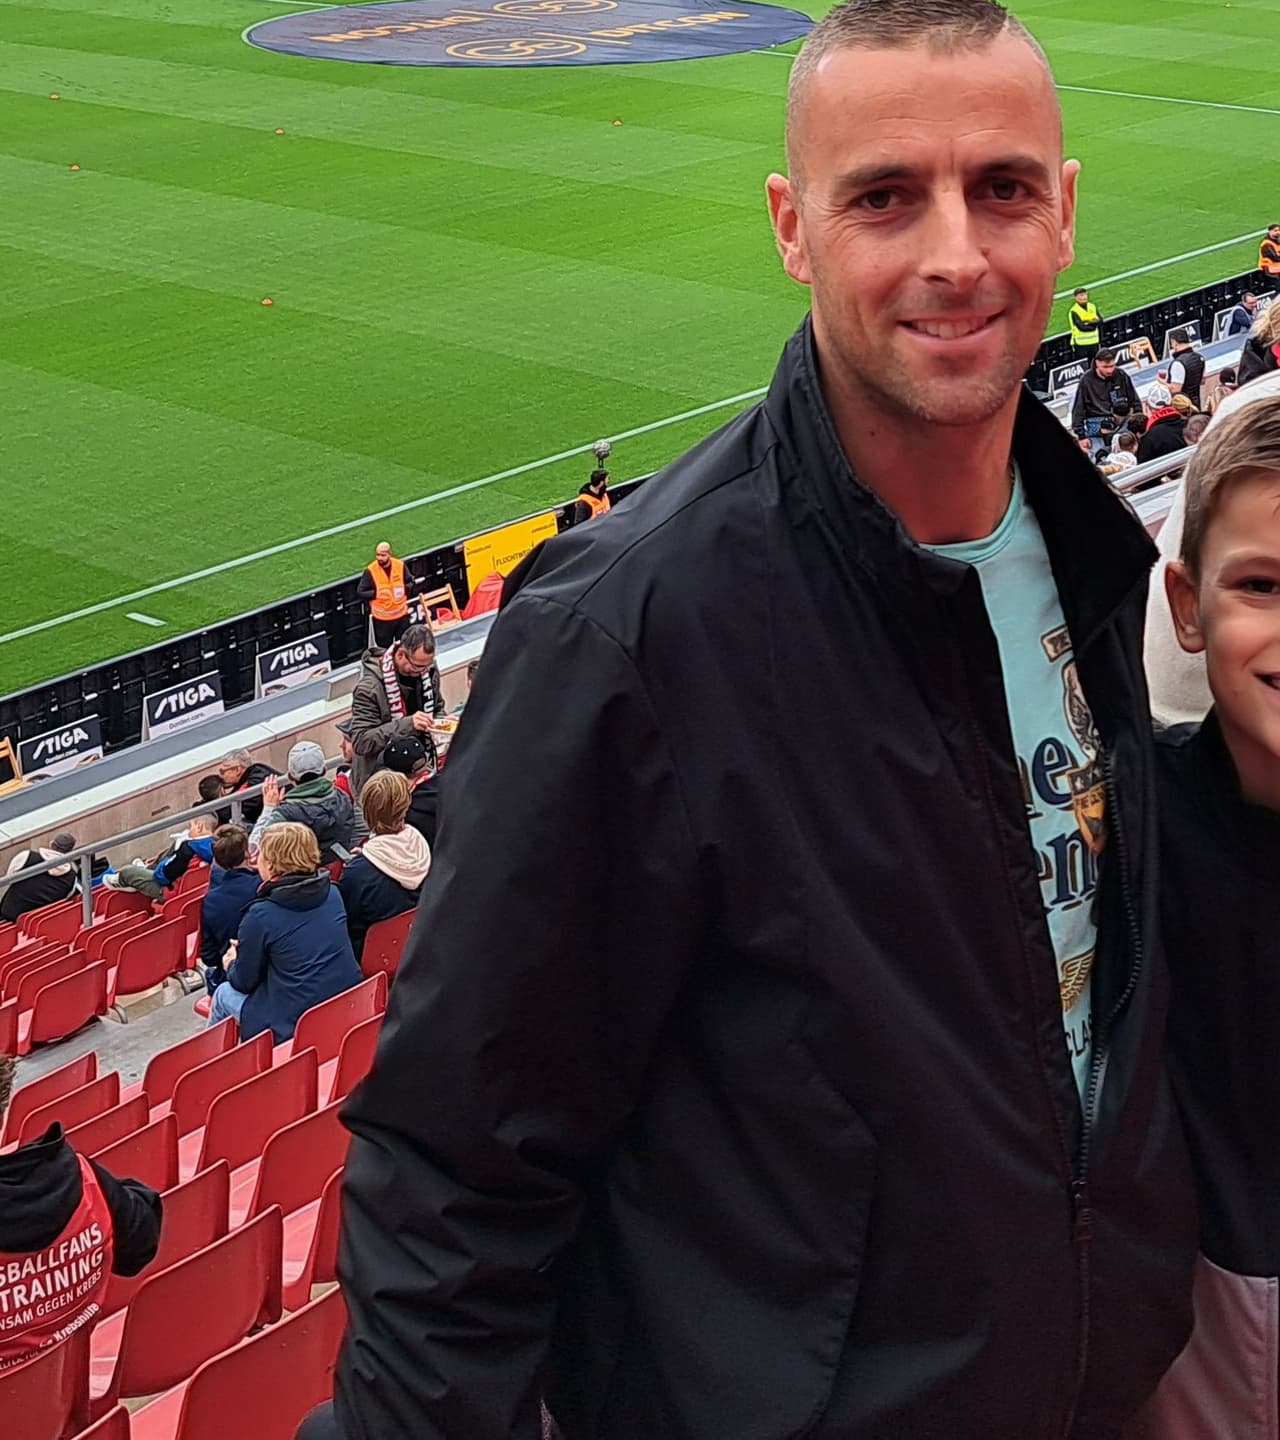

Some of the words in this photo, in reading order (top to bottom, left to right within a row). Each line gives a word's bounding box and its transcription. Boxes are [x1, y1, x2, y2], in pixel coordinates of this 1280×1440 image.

[269, 641, 321, 672] STIGA
[153, 685, 216, 720] STIGA
[32, 727, 89, 761] STIGA
[36, 1291, 74, 1322] GEGEN
[76, 1267, 102, 1304] KREBS
[53, 1302, 100, 1350] Krebshilfe
